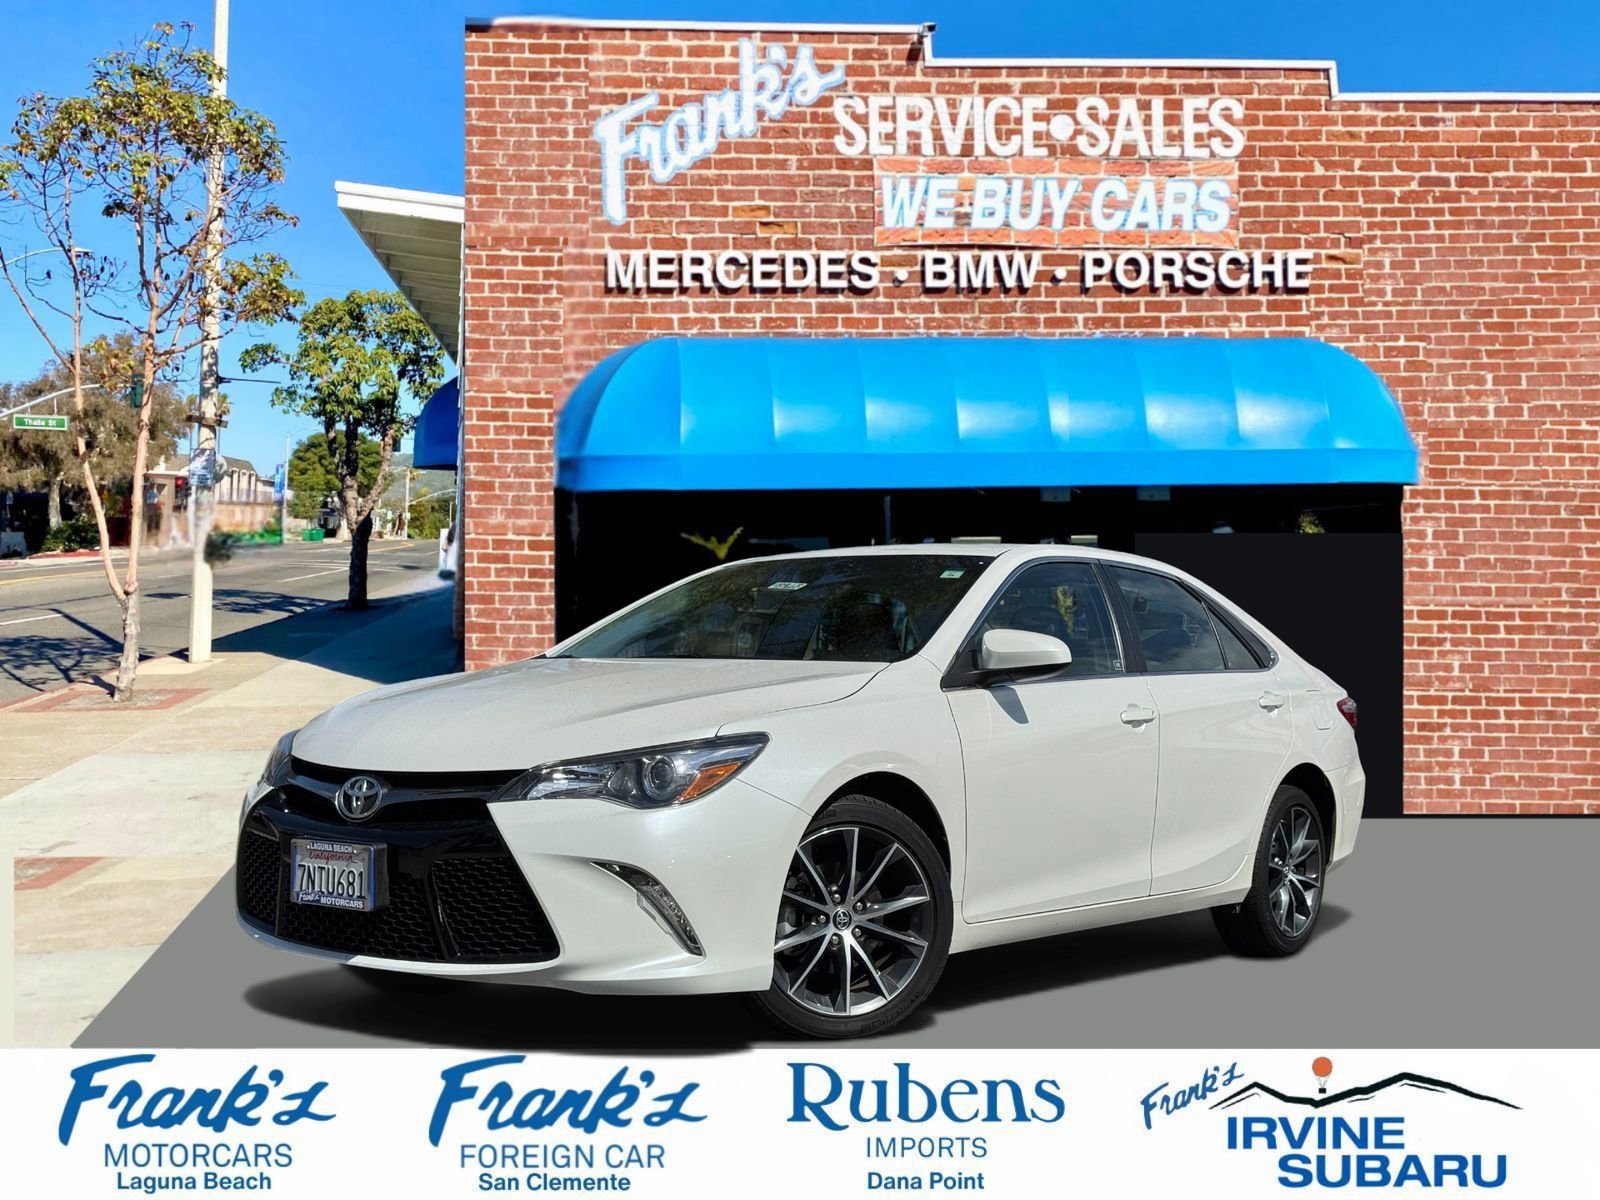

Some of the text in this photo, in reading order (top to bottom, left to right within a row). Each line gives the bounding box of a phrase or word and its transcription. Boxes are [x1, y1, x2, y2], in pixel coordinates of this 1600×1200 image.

[594, 38, 846, 224] Frank's
[881, 174, 1232, 232] WE BUY CARS
[606, 250, 1313, 289] MERCEDES BMW PORSCHE
[310, 842, 353, 853] LAGUNA BEACH
[320, 896, 364, 909] MOTORCARS
